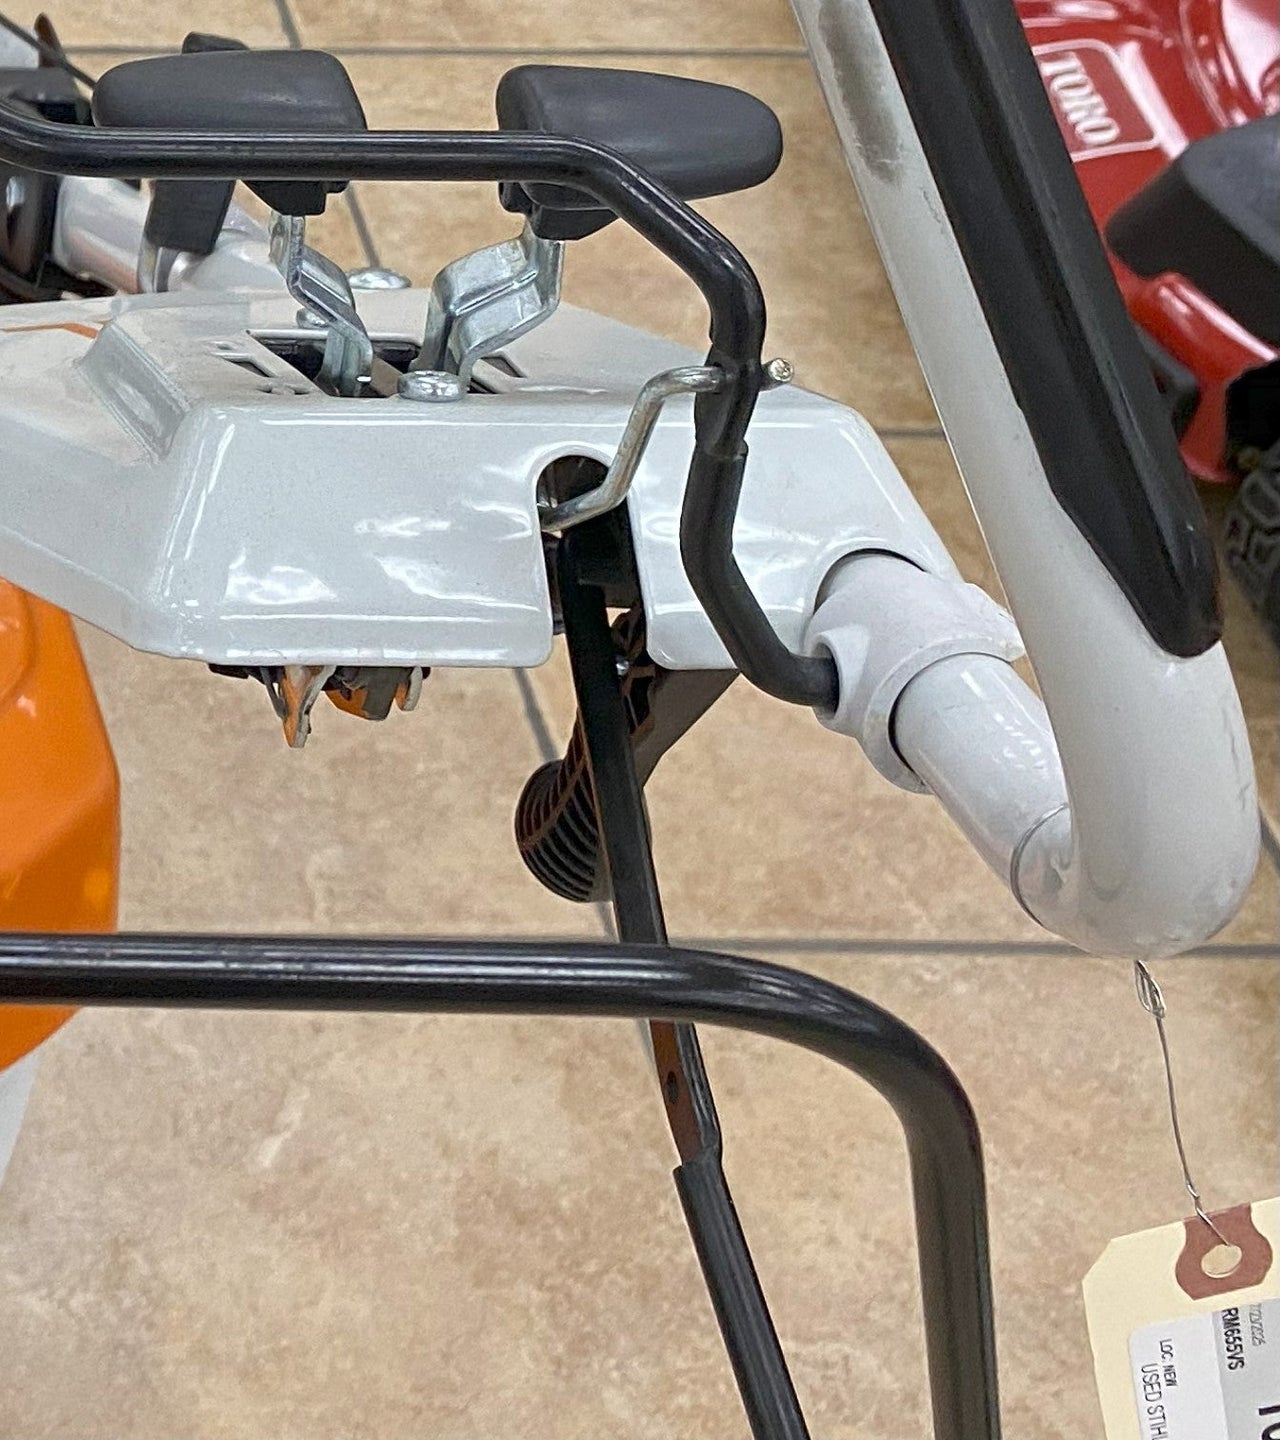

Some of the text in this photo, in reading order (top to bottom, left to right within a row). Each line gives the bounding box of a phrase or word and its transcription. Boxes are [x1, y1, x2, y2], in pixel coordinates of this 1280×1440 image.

[1041, 51, 1120, 146] TORO
[1221, 1307, 1245, 1371] RM655VS
[1141, 1362, 1163, 1402] USED
